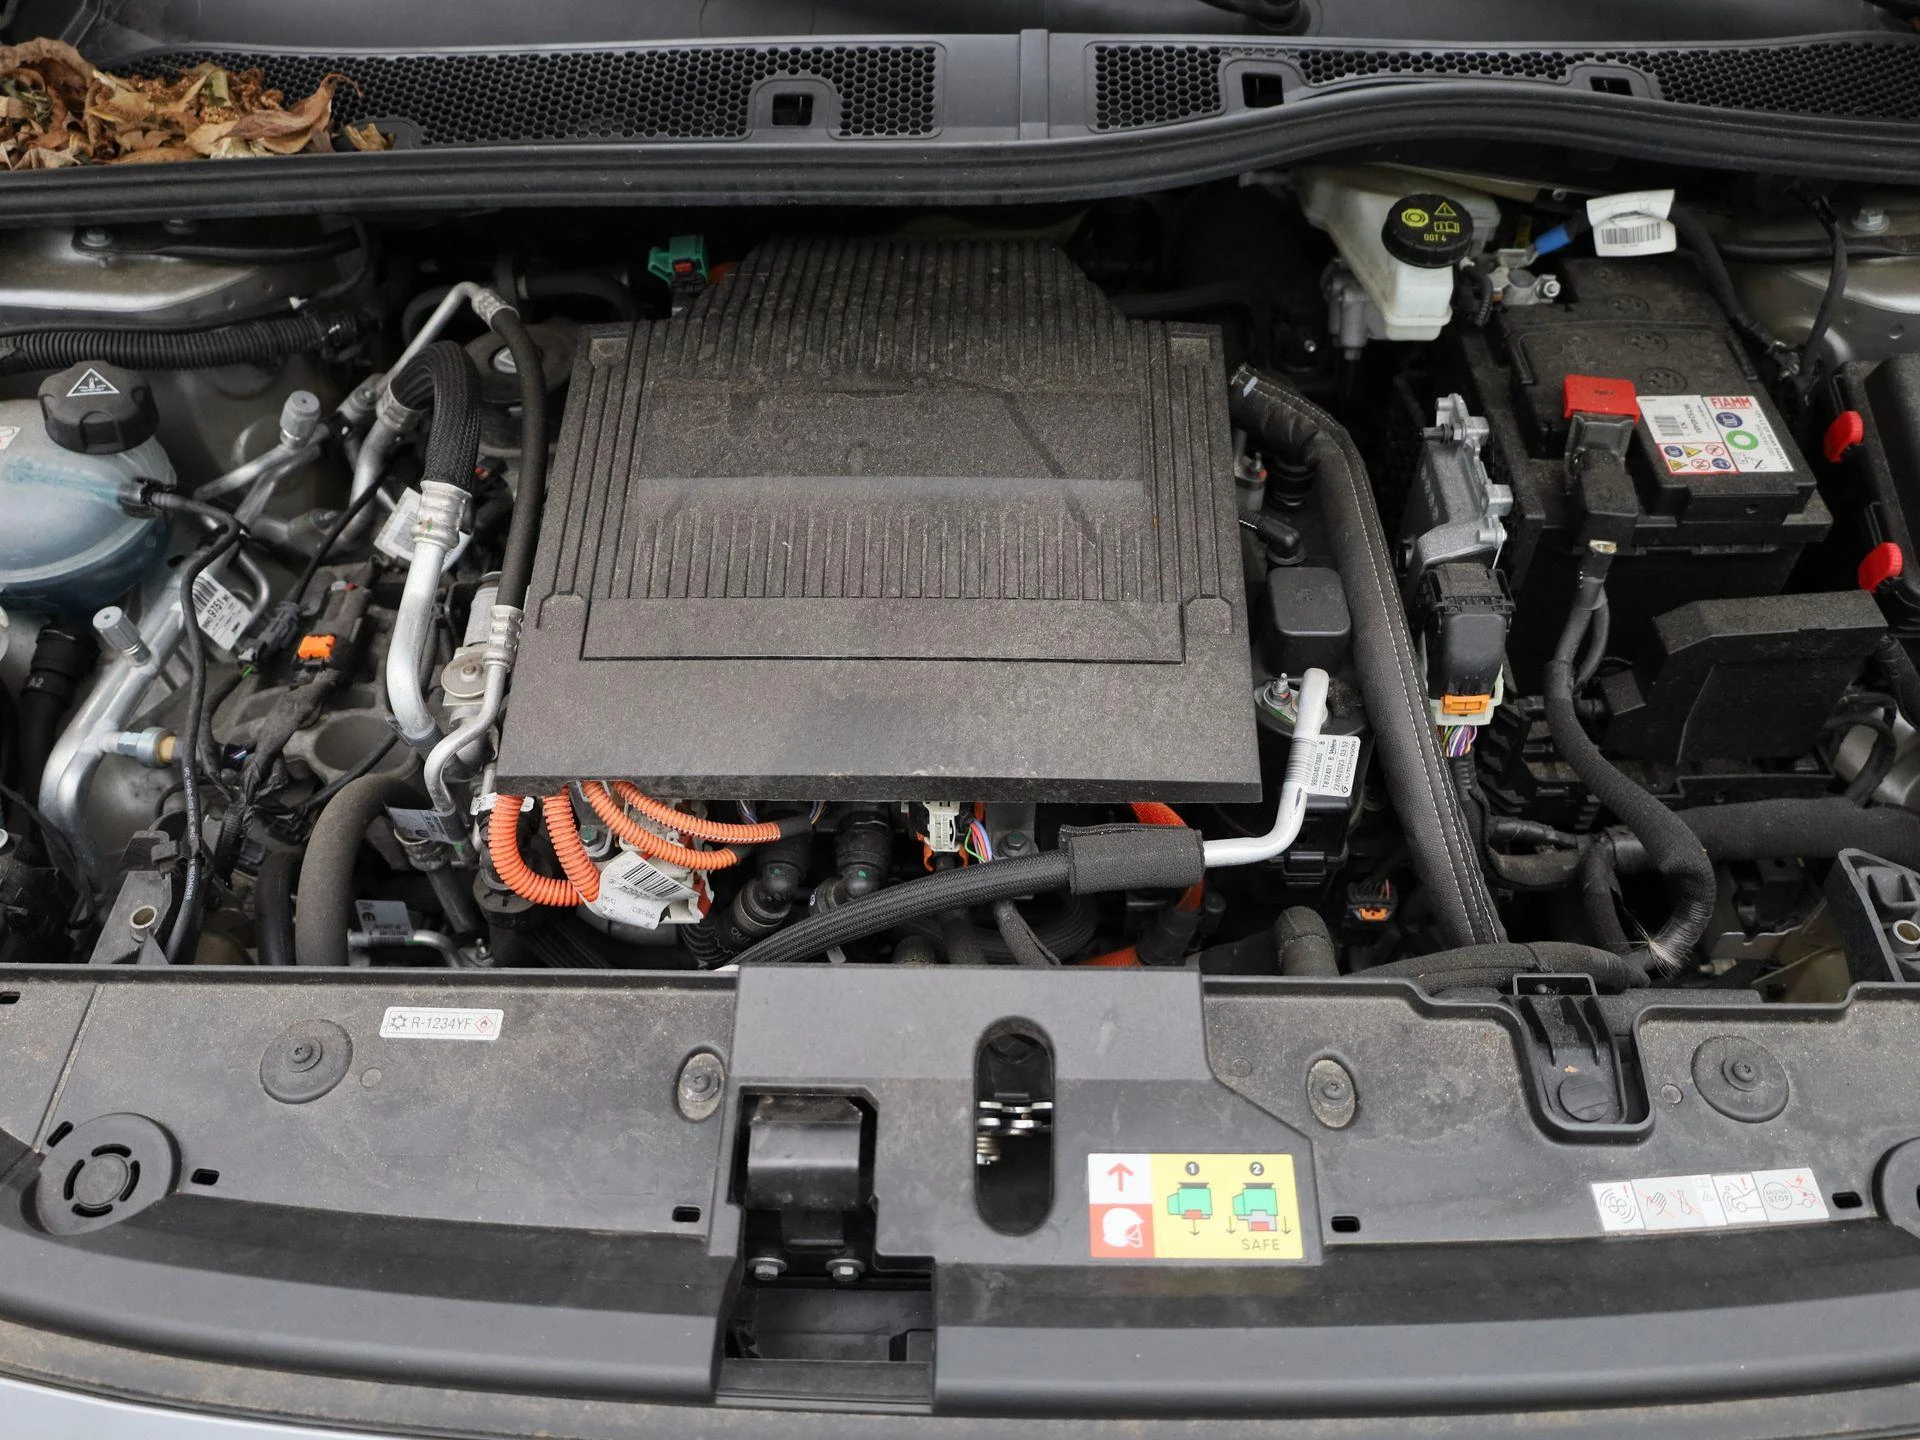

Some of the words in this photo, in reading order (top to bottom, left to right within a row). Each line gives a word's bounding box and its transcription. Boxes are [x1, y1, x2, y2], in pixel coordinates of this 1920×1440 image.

[1423, 233, 1439, 242] DOT
[1441, 234, 1447, 242] 4
[1710, 397, 1752, 408] FIAMM
[207, 597, 225, 618] 9751
[28, 676, 44, 688] A2
[411, 1016, 473, 1030] R-1234YF
[1768, 1195, 1790, 1204] STOP
[1241, 1238, 1280, 1251] SAFE
